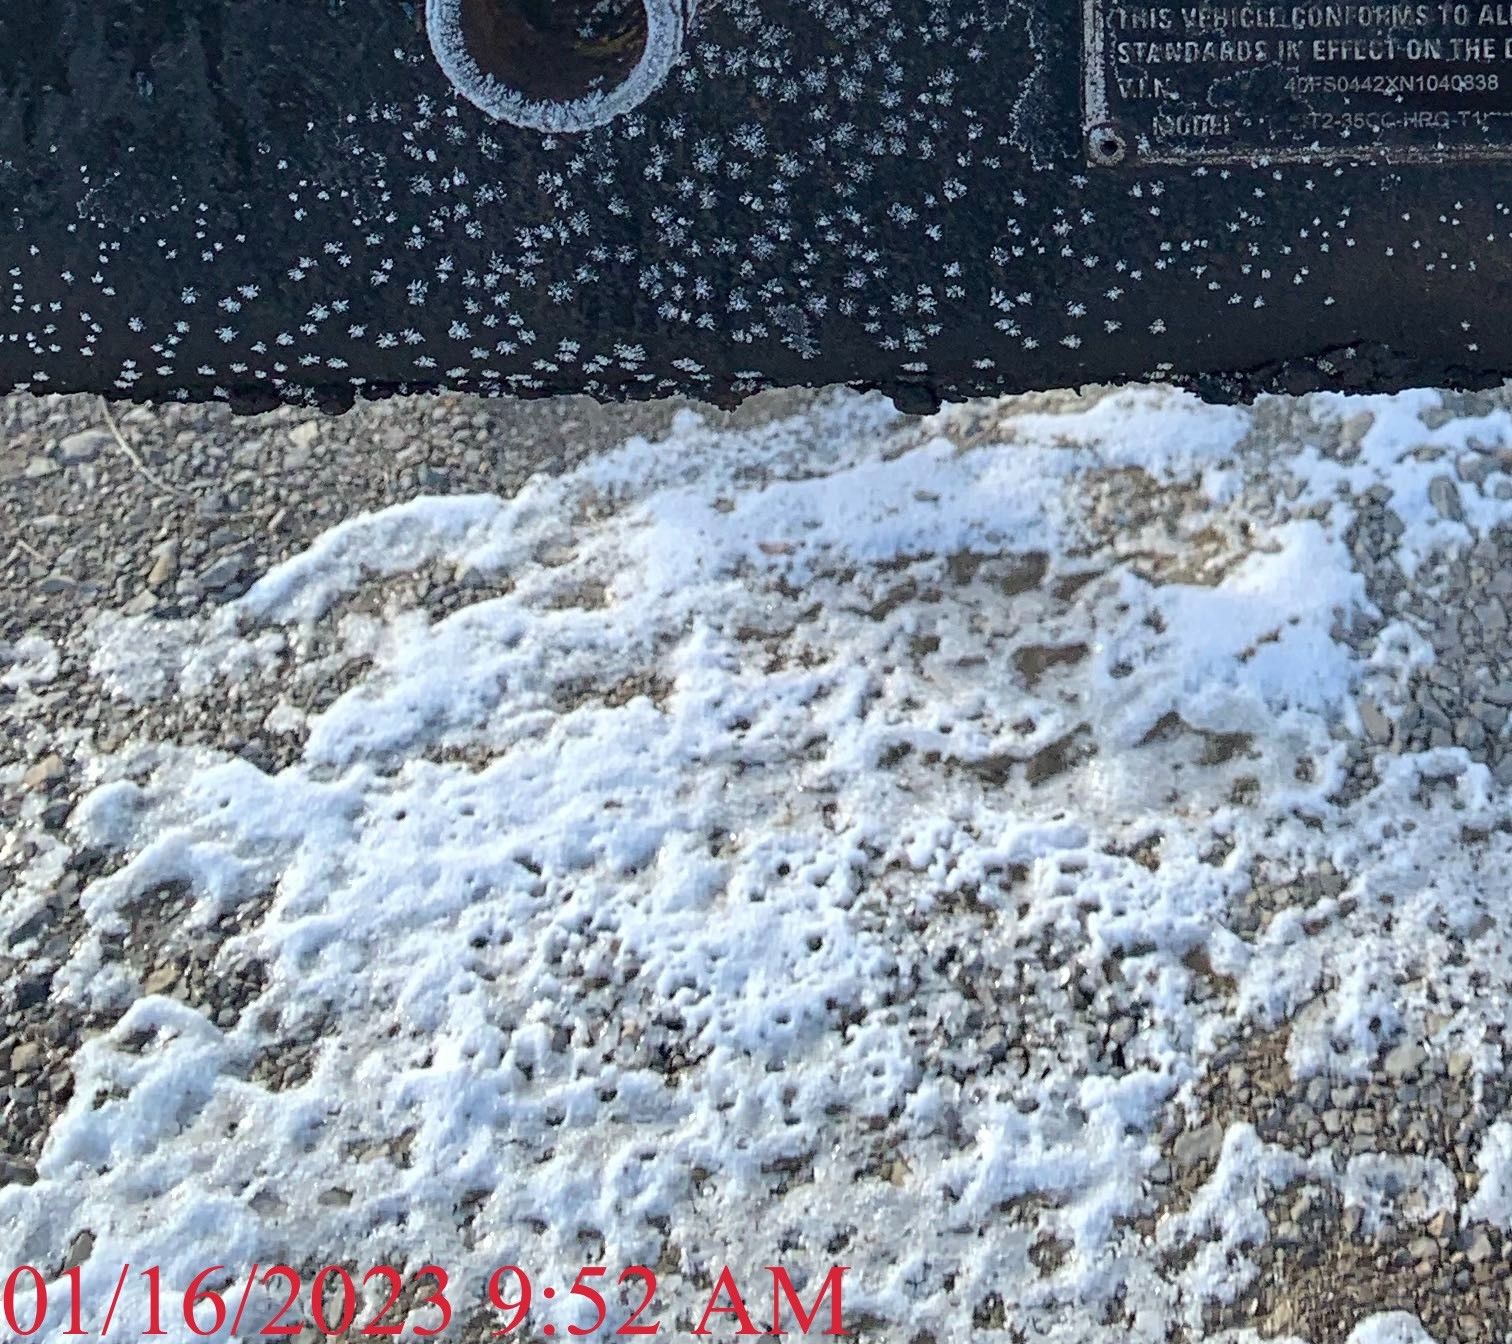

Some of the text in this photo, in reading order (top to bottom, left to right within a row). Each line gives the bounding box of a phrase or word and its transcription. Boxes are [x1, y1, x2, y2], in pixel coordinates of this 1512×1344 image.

[1439, 5, 1468, 26] TO
[1117, 42, 1267, 64] STANDARDS
[1406, 38, 1442, 61] ON
[1450, 38, 1496, 61] THE
